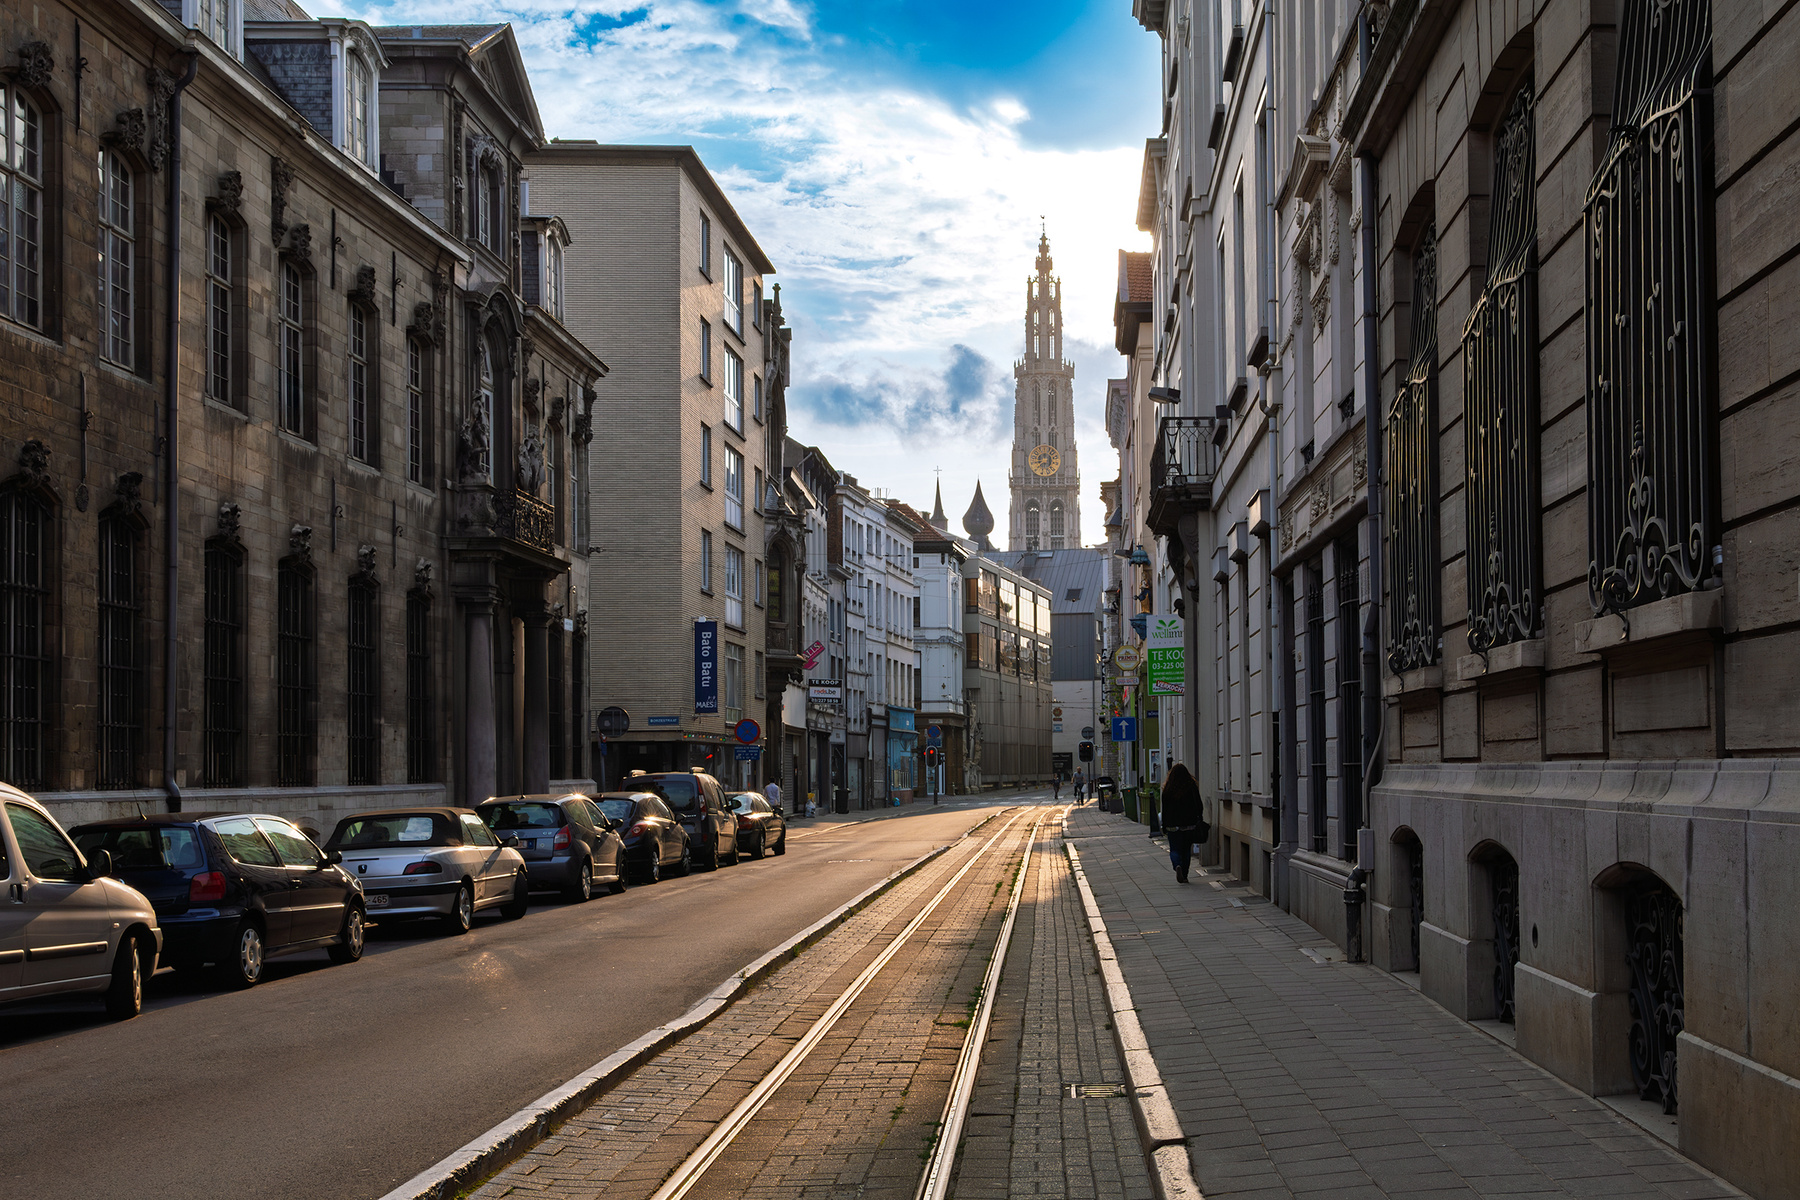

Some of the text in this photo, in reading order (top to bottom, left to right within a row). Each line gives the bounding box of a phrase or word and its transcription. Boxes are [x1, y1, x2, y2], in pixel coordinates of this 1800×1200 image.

[701, 631, 712, 657] Bato
[1151, 650, 1163, 661] TE
[1152, 661, 1174, 670] 03-225
[701, 661, 712, 687] Batu
[696, 701, 714, 709] MAES
